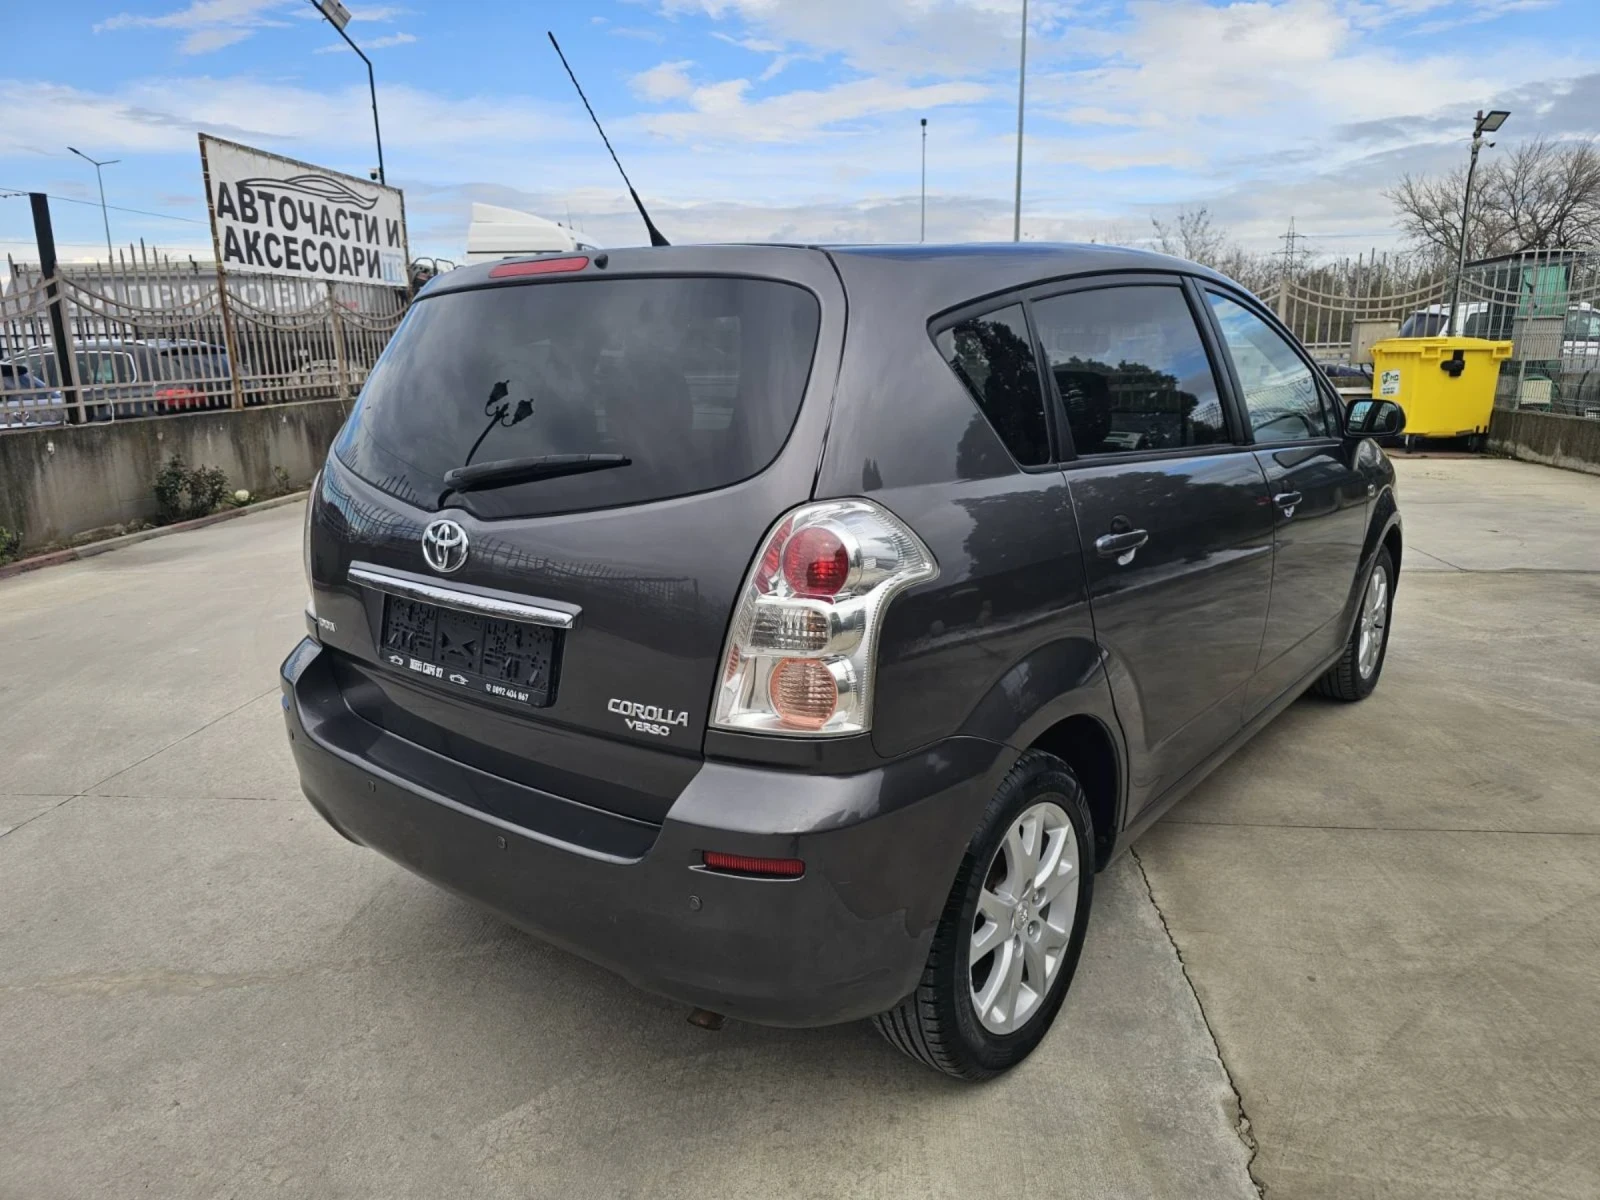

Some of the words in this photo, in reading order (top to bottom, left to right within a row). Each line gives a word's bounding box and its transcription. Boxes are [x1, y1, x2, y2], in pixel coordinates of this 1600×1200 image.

[217, 181, 380, 246] АВТОЧАСТИ
[386, 218, 401, 249] И
[223, 225, 382, 280] АКСЕСОАРИ
[607, 698, 689, 727] COROLLA
[624, 718, 670, 736] VERSO
